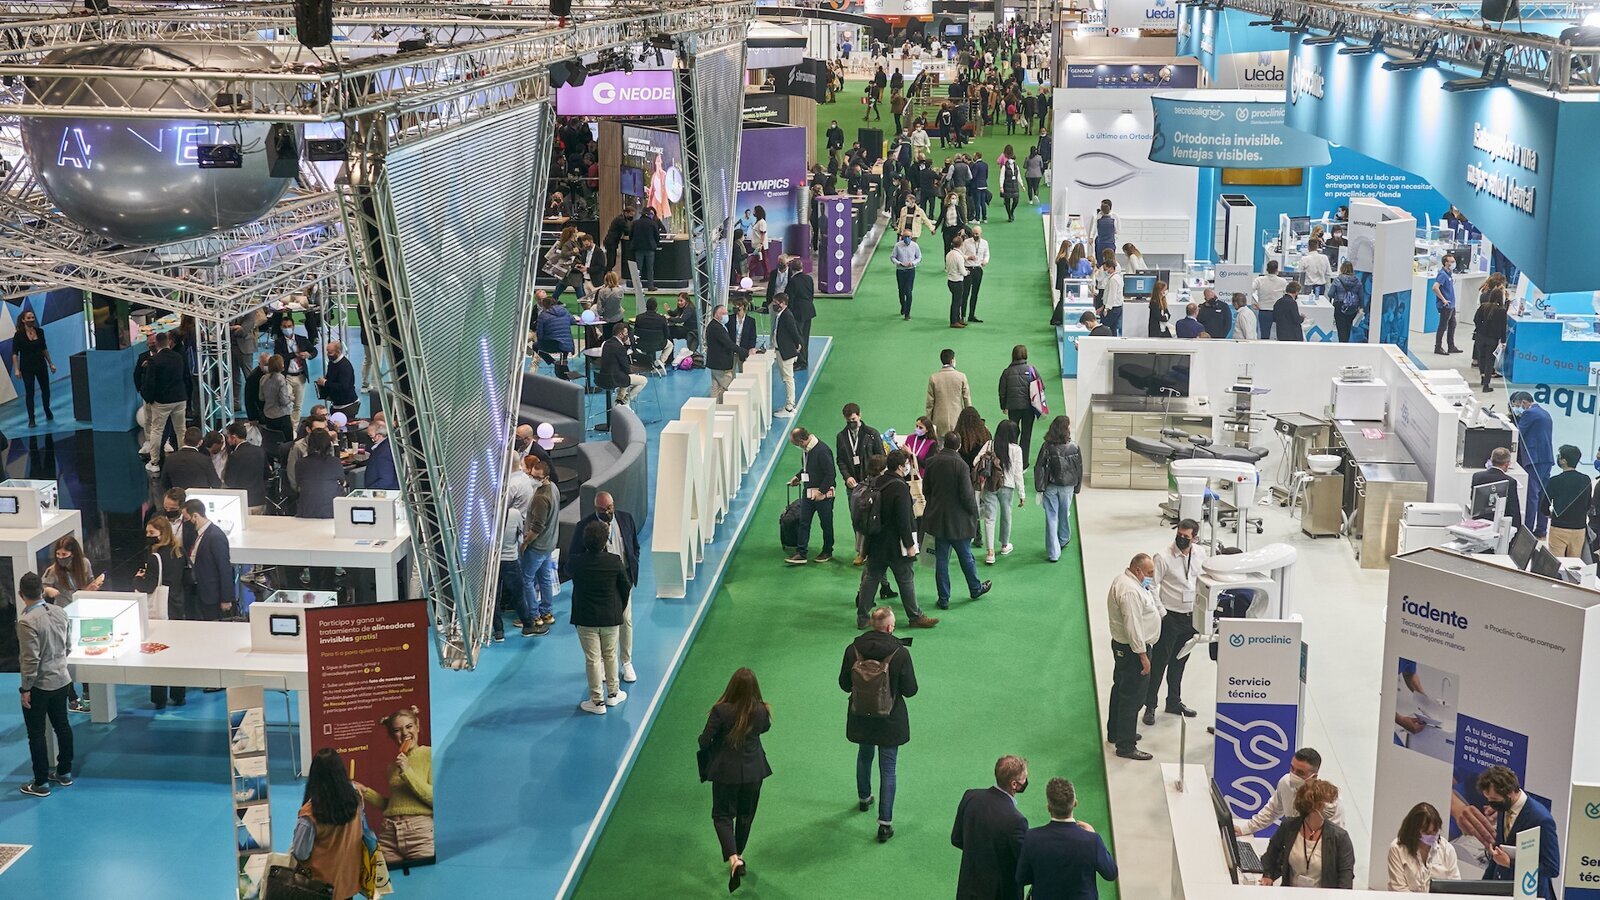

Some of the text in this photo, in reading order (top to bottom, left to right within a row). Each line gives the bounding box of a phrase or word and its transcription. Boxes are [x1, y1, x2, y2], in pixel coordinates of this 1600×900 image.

[619, 87, 674, 100] NEODE
[1174, 131, 1283, 146] Ortodoncia invisible.
[1172, 146, 1262, 162] Ventajas visibles.
[1522, 148, 1536, 171] una
[737, 178, 790, 191] EOLYMPICS
[1488, 169, 1508, 202] salud
[1508, 176, 1534, 214] dental
[1512, 348, 1538, 362] Todo
[1542, 355, 1550, 364] lo
[1554, 360, 1574, 369] que
[1534, 383, 1600, 416] aqu
[319, 619, 349, 627] Participa
[320, 627, 360, 635] tratamiento
[372, 622, 415, 631] alineadores
[1401, 618, 1454, 639] Tecnología dental
[320, 633, 378, 644] invisibles gratis!
[1248, 635, 1291, 645] proclinic
[1410, 629, 1418, 637] las
[1420, 633, 1443, 645] mejores
[1445, 640, 1465, 651] manos
[1490, 624, 1515, 637] Proclinic
[1516, 632, 1535, 643] Group
[1537, 640, 1565, 653] company
[1228, 677, 1271, 686] Servicio
[1228, 689, 1267, 698] técnico
[1465, 736, 1478, 744] que
[1488, 743, 1510, 756] clínica
[1481, 730, 1496, 741] lado
[1498, 737, 1513, 747] para
[1464, 745, 1507, 764] esté siempre
[1469, 754, 1476, 762] la
[1579, 872, 1600, 882] téc
